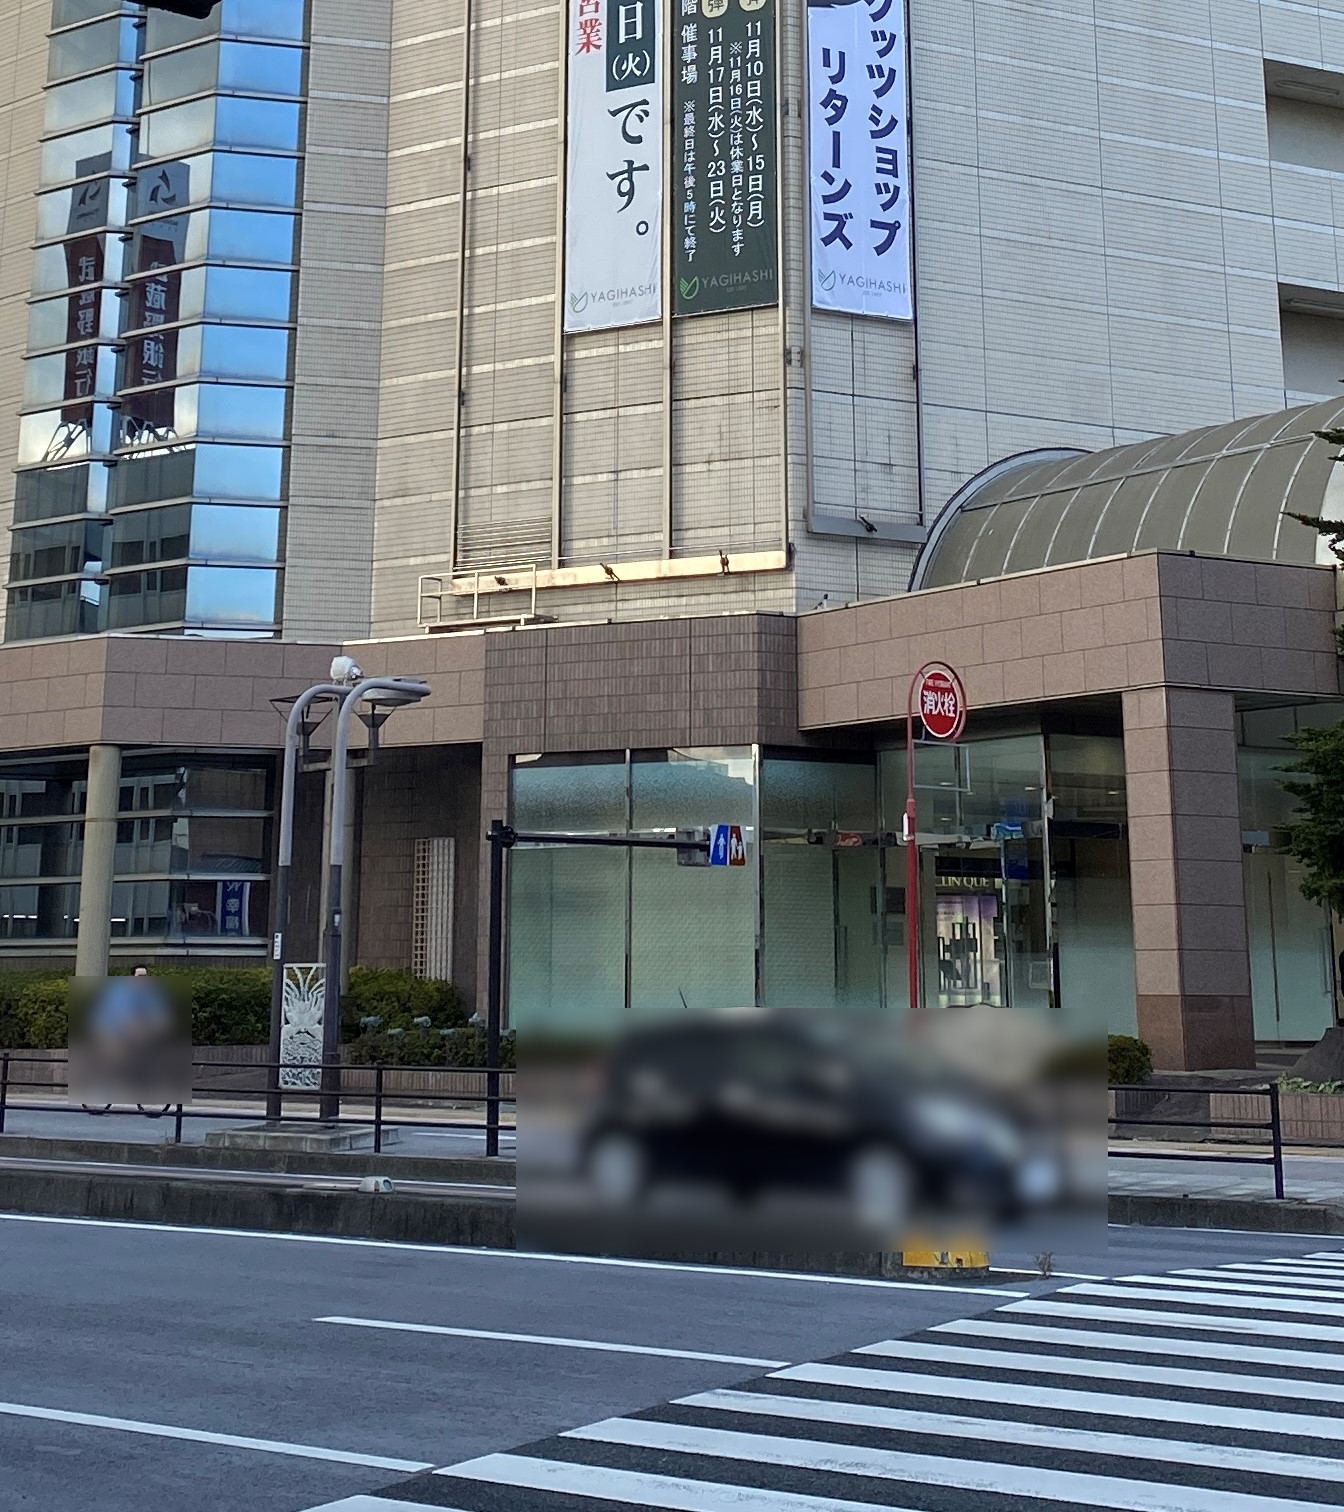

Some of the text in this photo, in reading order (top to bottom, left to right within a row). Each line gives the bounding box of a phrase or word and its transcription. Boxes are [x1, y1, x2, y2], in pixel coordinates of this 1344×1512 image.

[820, 47, 854, 251] リターンズ
[702, 268, 773, 288] YAGIHASHI
[838, 273, 906, 294] YAGIHASHI
[590, 284, 656, 303] YAGIHASHI
[923, 690, 955, 718] 消火栓
[935, 876, 990, 889] LINQUE
